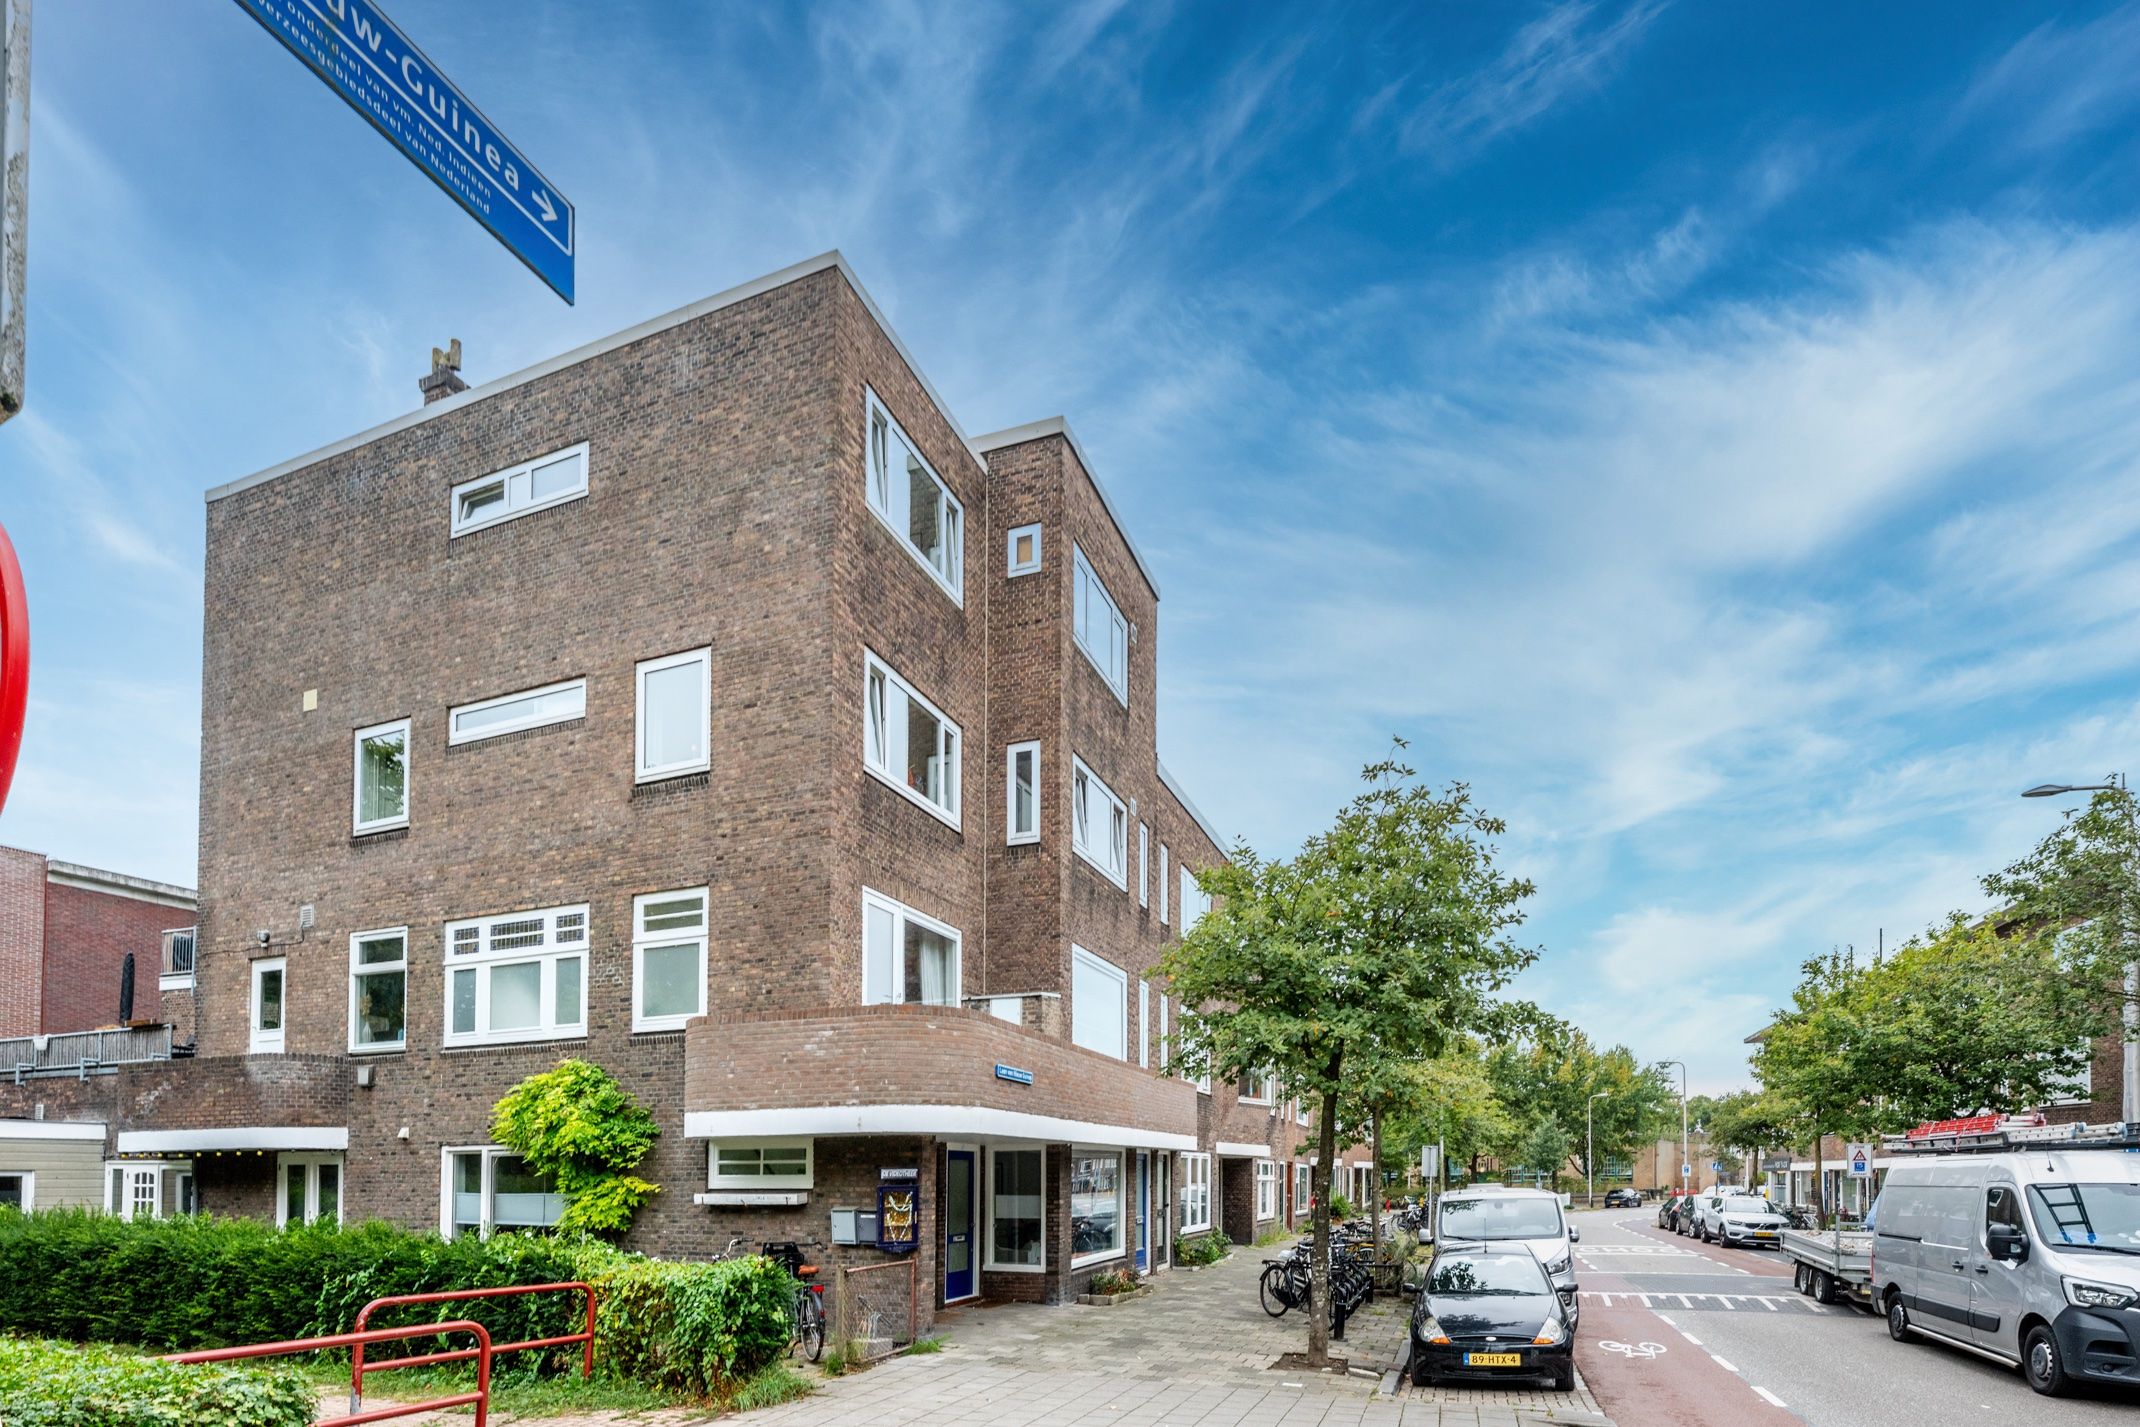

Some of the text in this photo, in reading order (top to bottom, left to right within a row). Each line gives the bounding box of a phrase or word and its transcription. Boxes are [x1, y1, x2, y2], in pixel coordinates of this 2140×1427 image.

[287, 1, 361, 77] onderdeel
[366, 74, 388, 103] van
[393, 99, 415, 127] vm.
[419, 123, 445, 156] Ned.
[405, 131, 427, 157] van
[431, 152, 490, 215] Nederland
